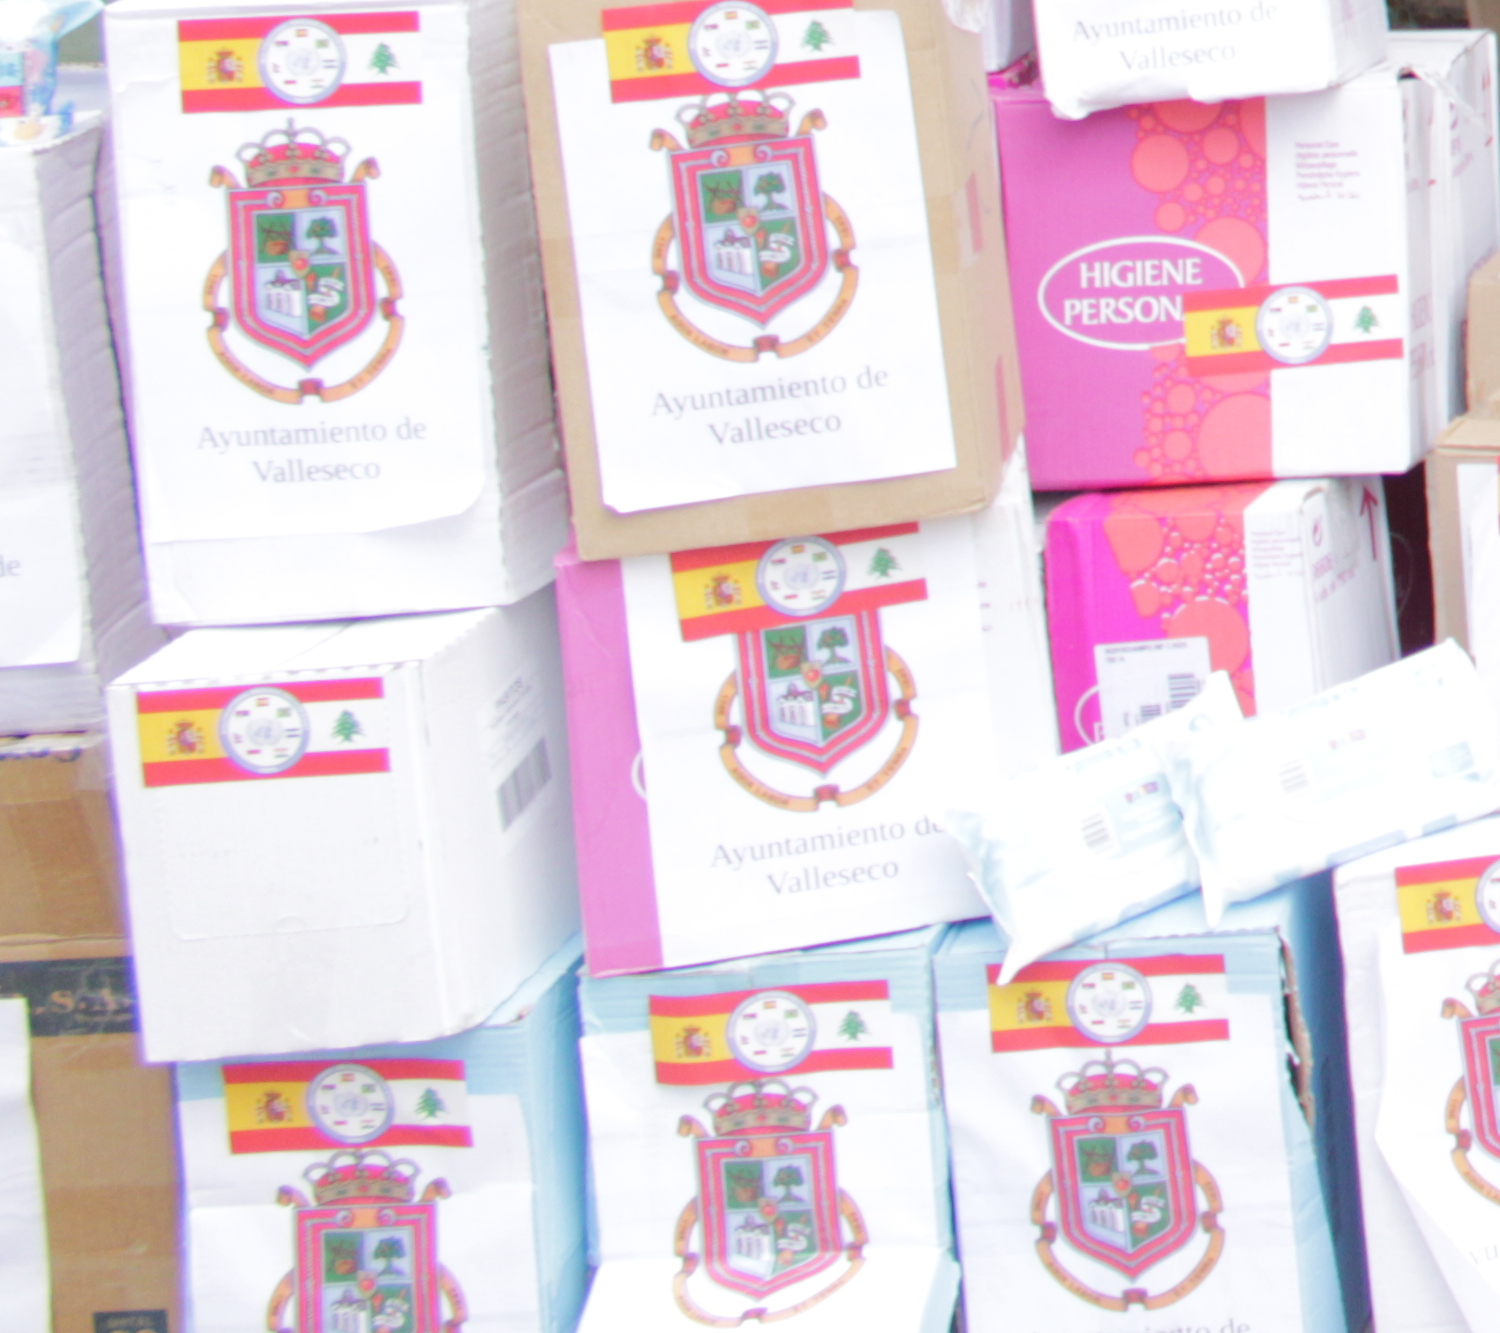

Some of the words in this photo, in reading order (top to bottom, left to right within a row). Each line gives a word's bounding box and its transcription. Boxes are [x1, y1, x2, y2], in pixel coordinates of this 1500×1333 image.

[1071, 3, 1243, 46] Ayuntamiento
[1249, 0, 1279, 23] de
[1118, 41, 1237, 73] Valleseco
[1079, 257, 1203, 290] HIGIENE
[1064, 295, 1185, 326] PERSON
[651, 371, 845, 420] Ayuntamiento
[853, 361, 890, 396] de
[196, 417, 388, 452] Ayuntamiento
[395, 413, 428, 442] de
[708, 409, 843, 448] Valleseco
[251, 455, 382, 484] Valleseco
[709, 821, 906, 871] Ayuntamiento
[914, 814, 946, 837] de
[765, 860, 900, 895] Valleseco
